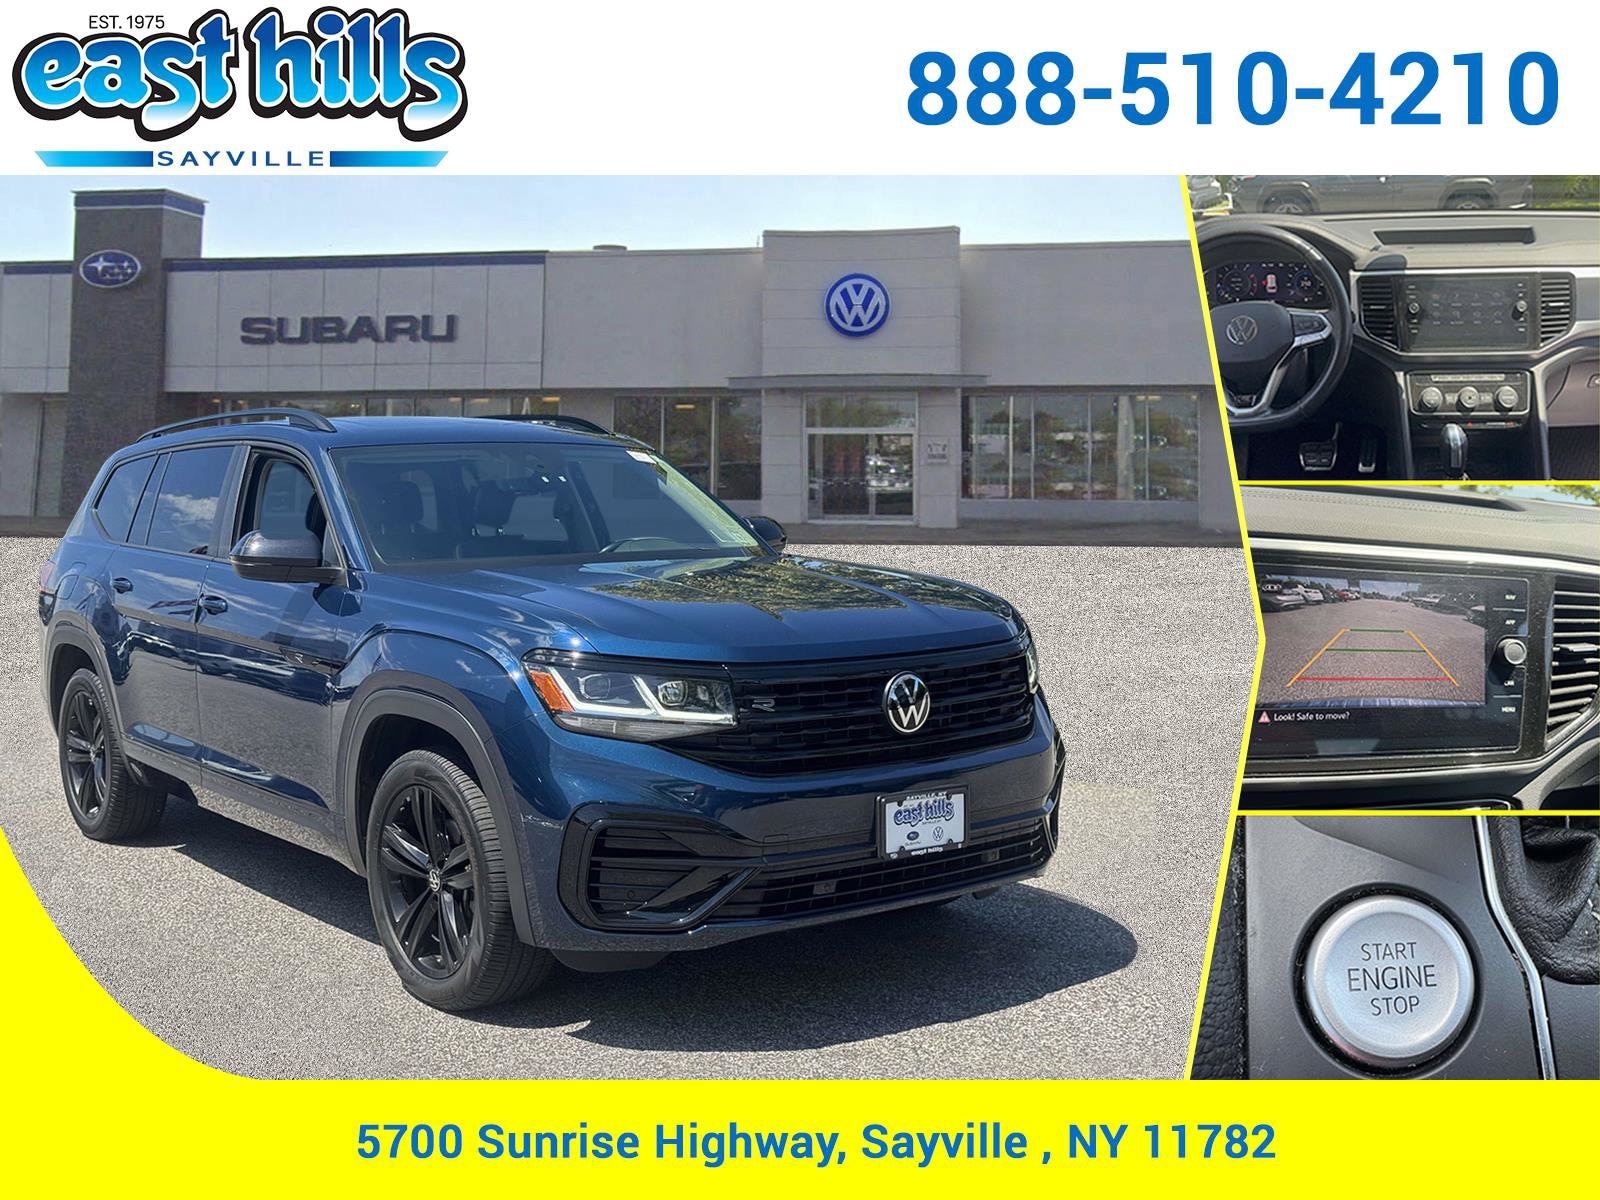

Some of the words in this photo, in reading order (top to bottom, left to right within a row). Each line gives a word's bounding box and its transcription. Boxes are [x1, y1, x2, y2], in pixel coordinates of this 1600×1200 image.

[240, 314, 458, 346] SUBARU
[1273, 712, 1295, 721] Look!
[1296, 712, 1314, 721] Safe
[1315, 712, 1324, 720] to
[1325, 711, 1350, 720] move?
[894, 802, 923, 827] east
[924, 797, 955, 821] hills
[1360, 941, 1418, 962] START
[1347, 964, 1437, 992] ENGINE
[1369, 995, 1420, 1017] STOP
